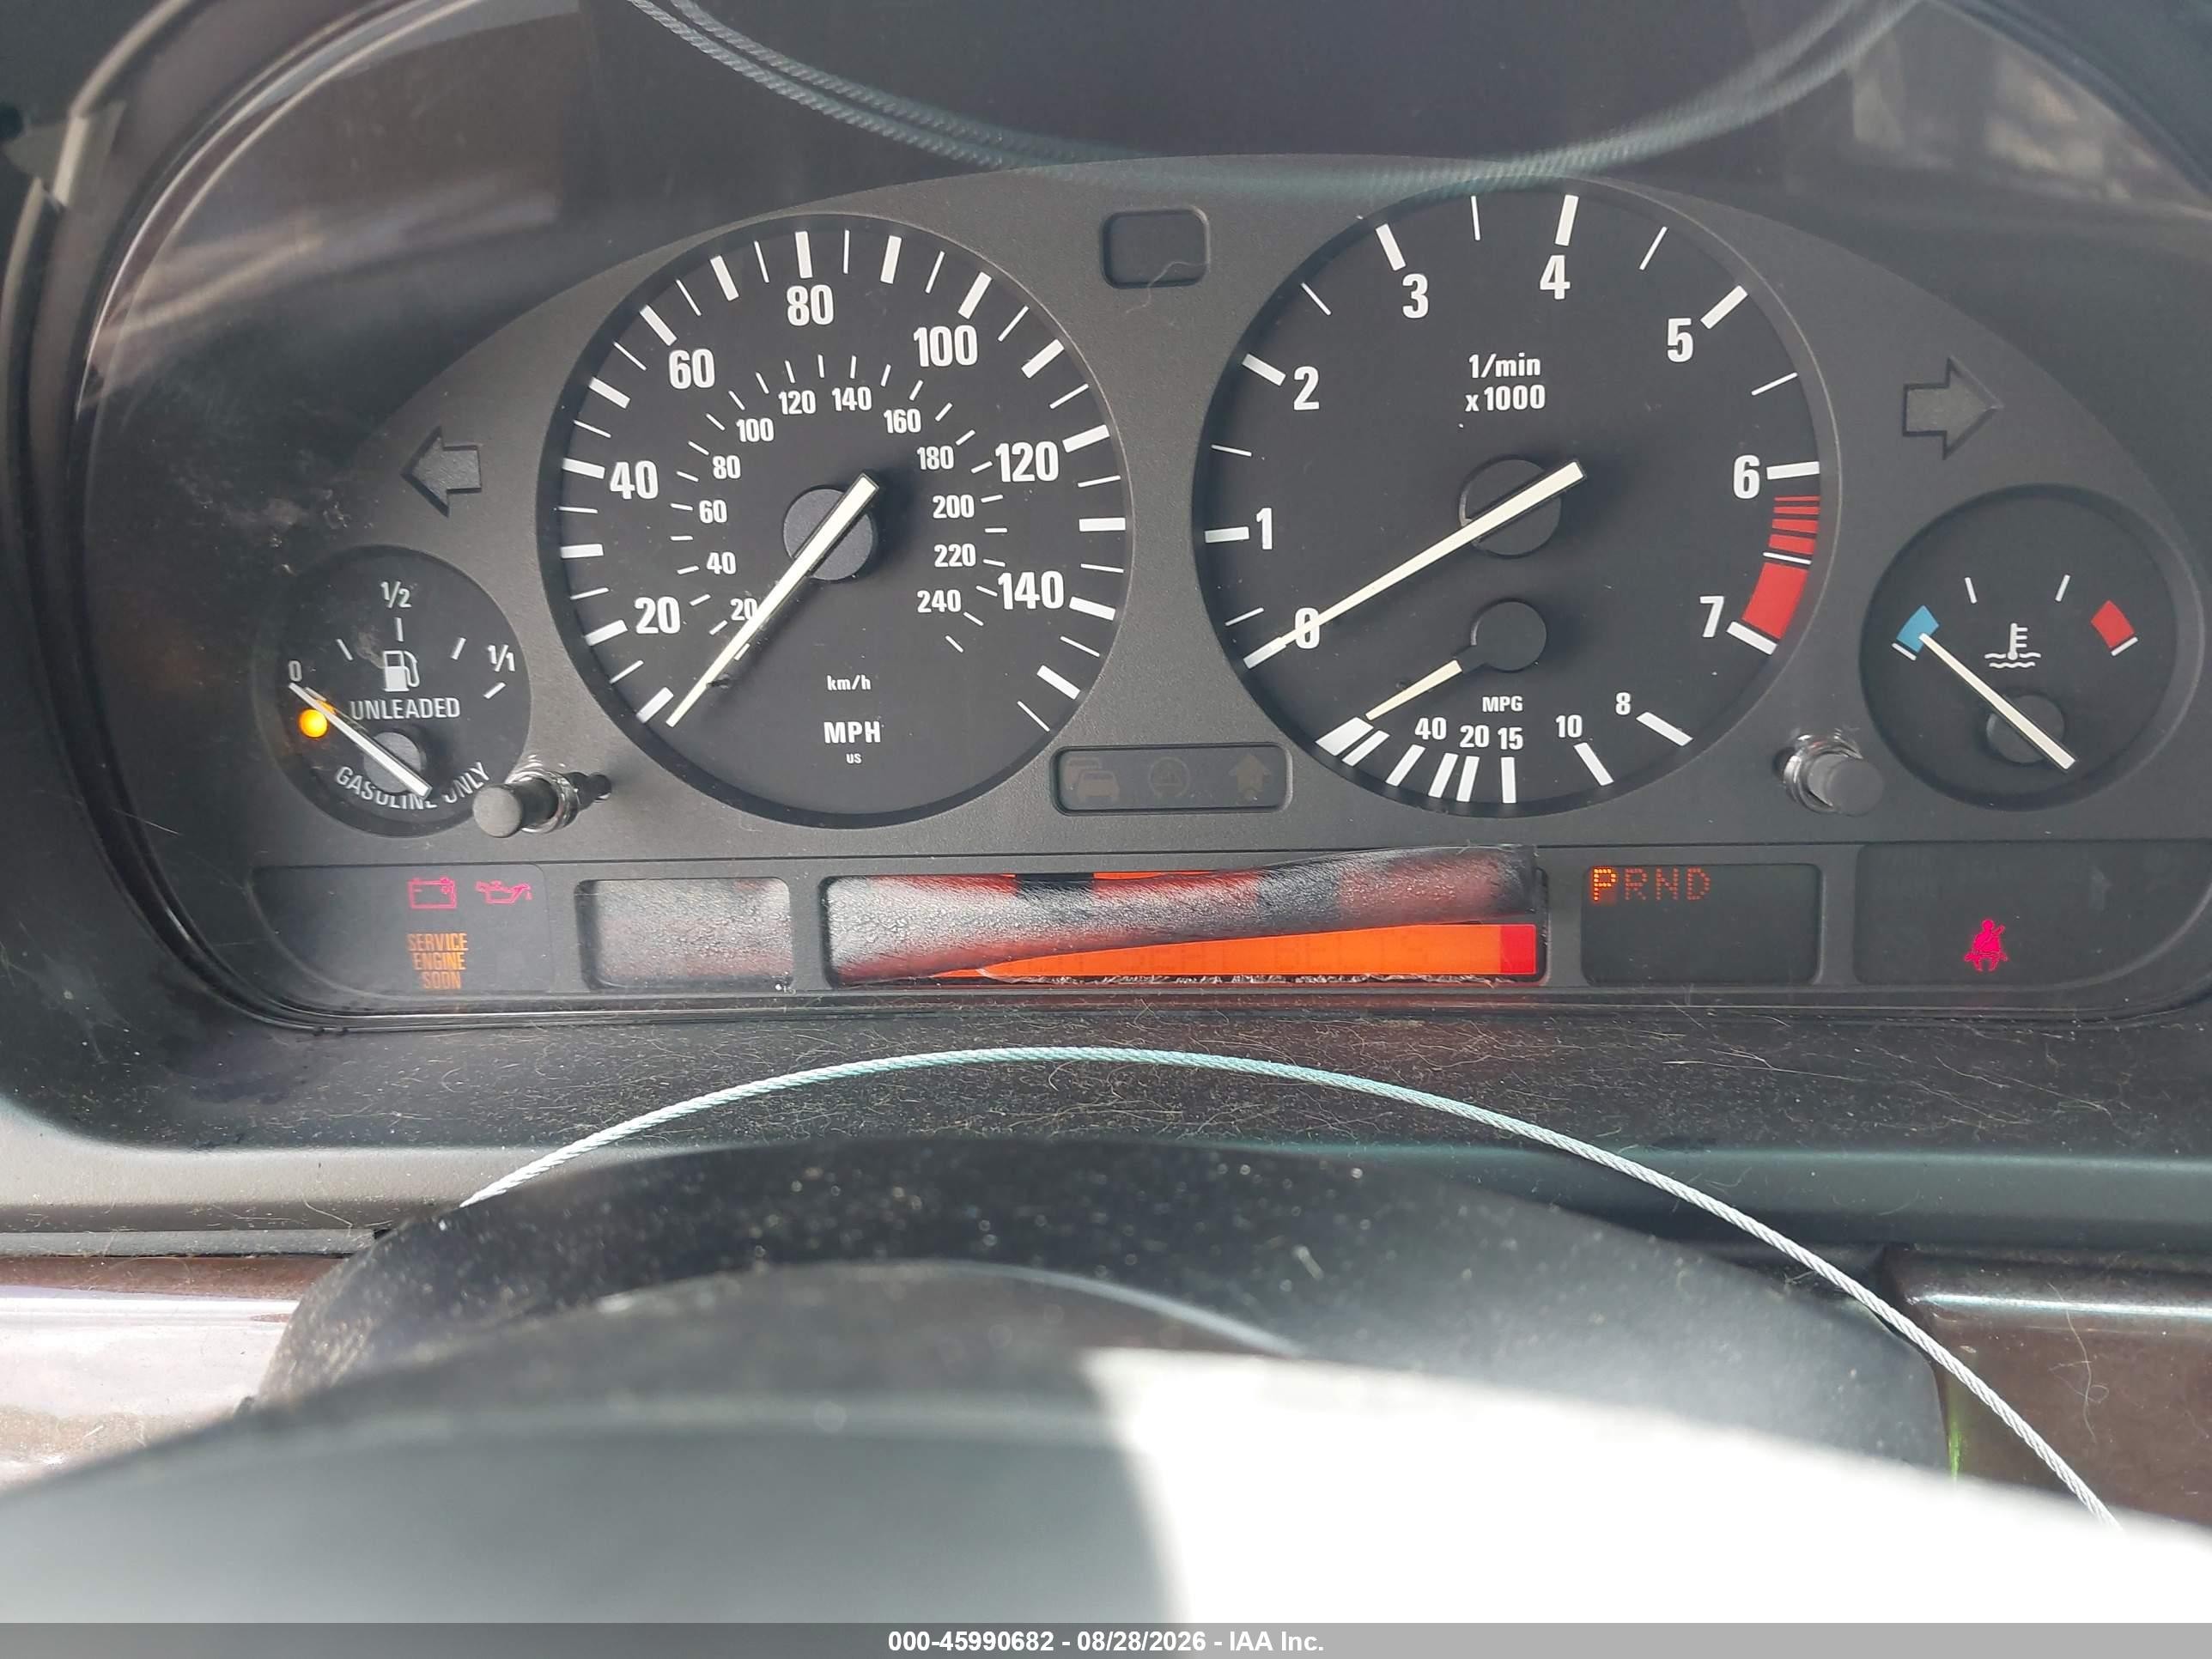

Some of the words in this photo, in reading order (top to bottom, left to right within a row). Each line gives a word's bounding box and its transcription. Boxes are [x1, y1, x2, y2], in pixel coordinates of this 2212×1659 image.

[1540, 255, 1571, 300] 4
[787, 284, 834, 326] 80
[1402, 273, 1429, 319] 3
[913, 325, 978, 367] 100
[1667, 318, 1693, 362] 5
[668, 349, 715, 389] 60
[1468, 352, 1540, 379] 1/min
[831, 386, 872, 411] 140
[1293, 366, 1320, 410] 2
[778, 390, 817, 415] 120
[736, 417, 775, 442] 100
[884, 409, 921, 434] 160
[712, 455, 741, 479] 80
[916, 446, 955, 470] 180
[995, 441, 1060, 483] 120
[609, 460, 659, 500] 40
[1733, 455, 1761, 500] 6
[698, 500, 728, 524] 60
[932, 495, 975, 519] 200
[1255, 507, 1273, 550] 1
[706, 552, 737, 574] 40
[933, 544, 977, 568] 220
[916, 589, 962, 613] 240
[998, 571, 1065, 610] 140
[634, 597, 681, 634] 20
[730, 598, 758, 621] 20
[1699, 595, 1724, 638] 7
[1294, 607, 1321, 649] 0
[288, 659, 303, 683] 0
[826, 675, 872, 690] km/h
[349, 697, 460, 720] UNLEADED
[1482, 696, 1523, 713] MPG
[1615, 692, 1632, 715] 8
[823, 720, 881, 744] MPH
[1414, 717, 1448, 741] 40
[1459, 725, 1490, 748] 20
[1555, 714, 1583, 738] 10
[1497, 727, 1524, 750] 15
[846, 753, 862, 764] US
[406, 933, 469, 951] SERVICE
[412, 951, 466, 970] ENGINE
[421, 971, 461, 989] SOON
